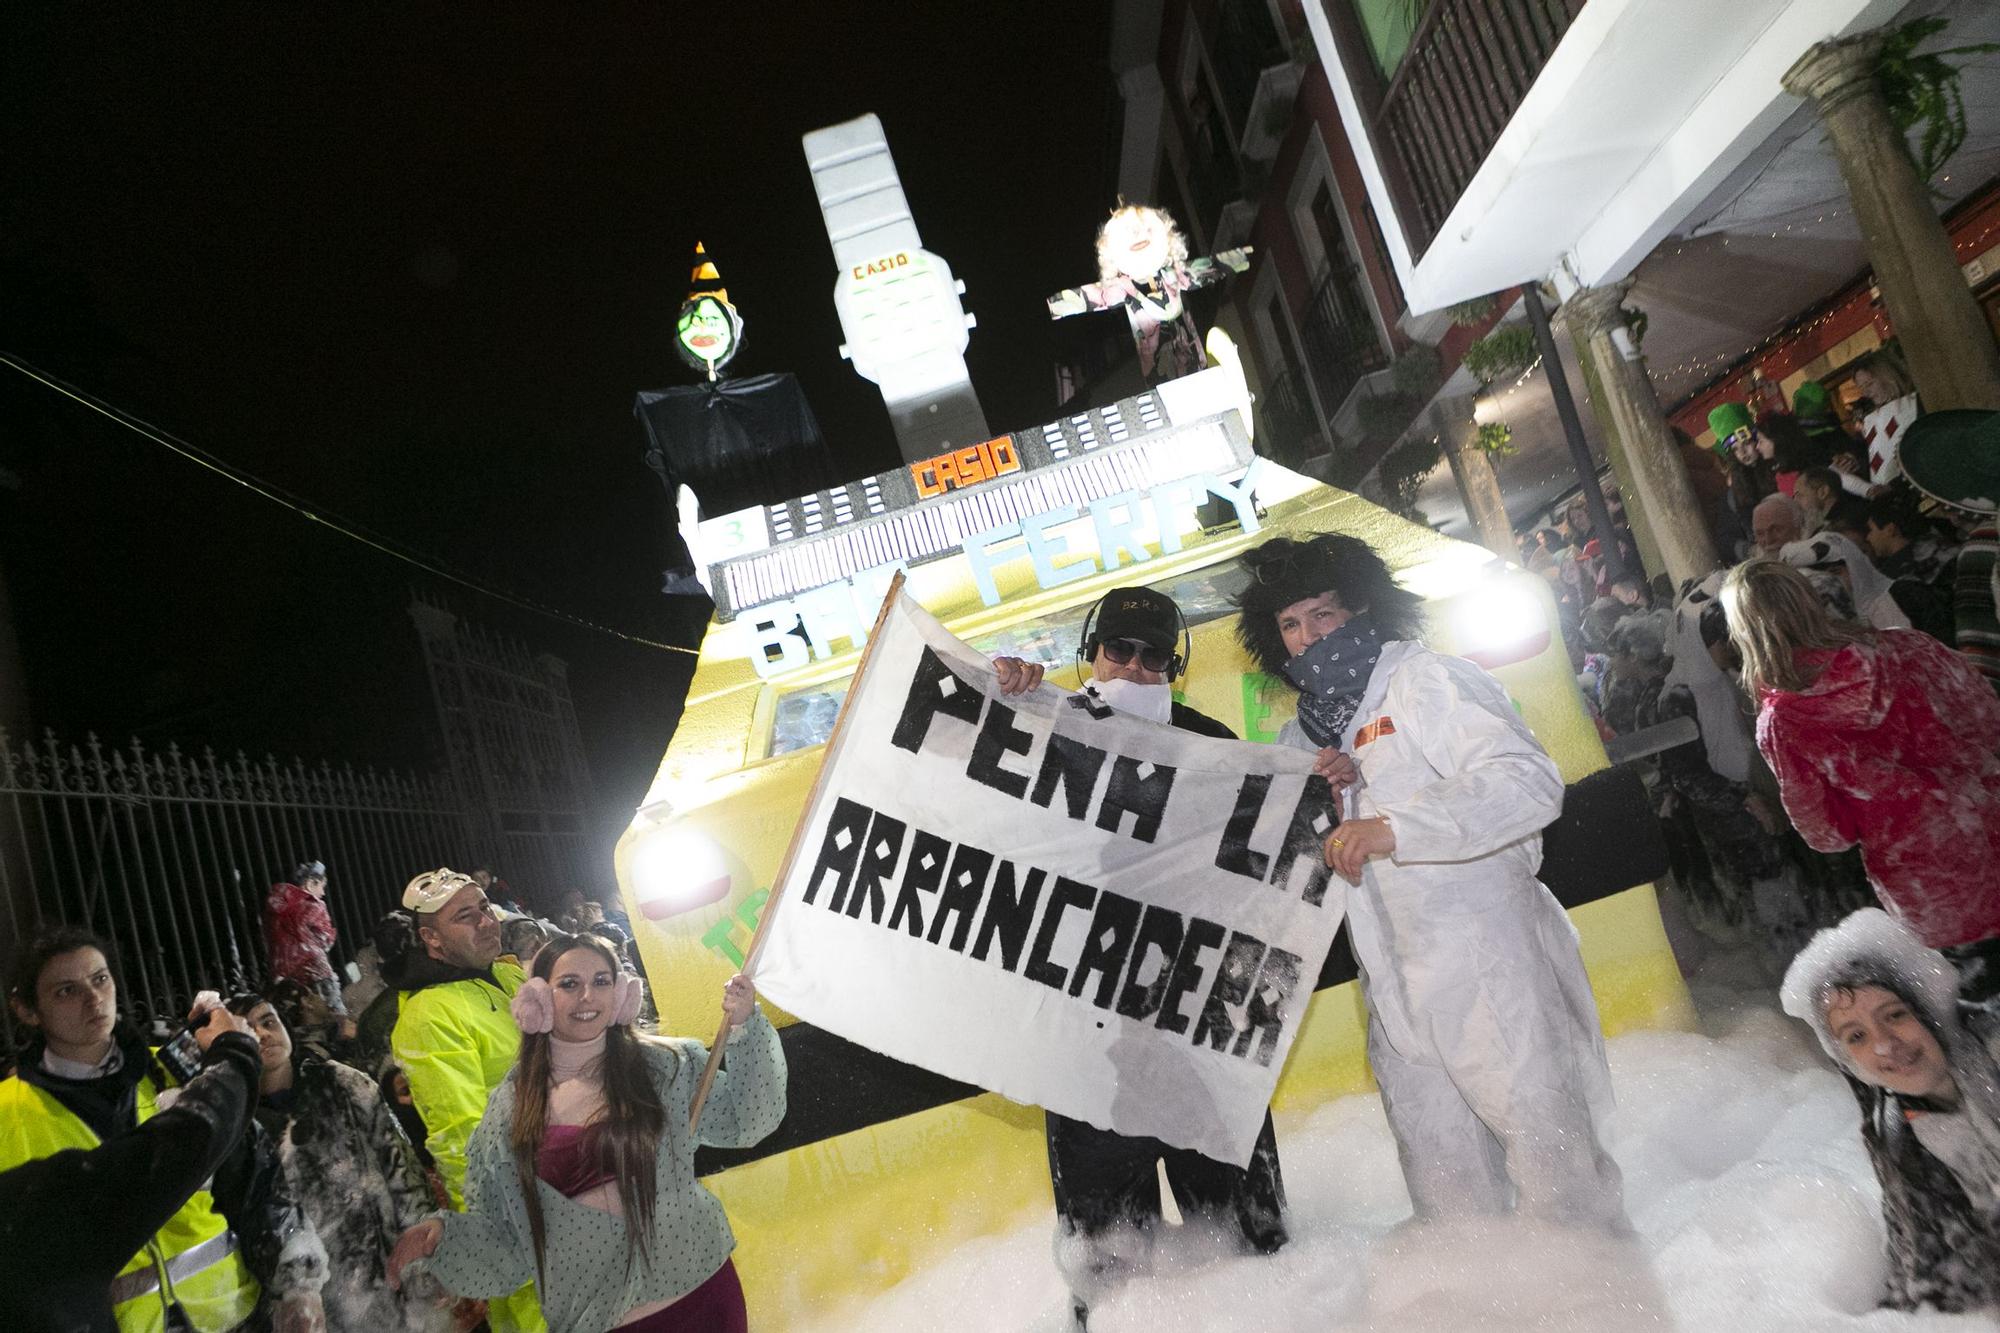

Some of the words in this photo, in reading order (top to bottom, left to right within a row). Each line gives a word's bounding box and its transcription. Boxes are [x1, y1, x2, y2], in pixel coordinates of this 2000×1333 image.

[853, 253, 909, 281] CASIO
[910, 435, 1021, 500] CASIO
[1215, 773, 1339, 908] LA
[802, 796, 1303, 1067] ARRANCADERA
